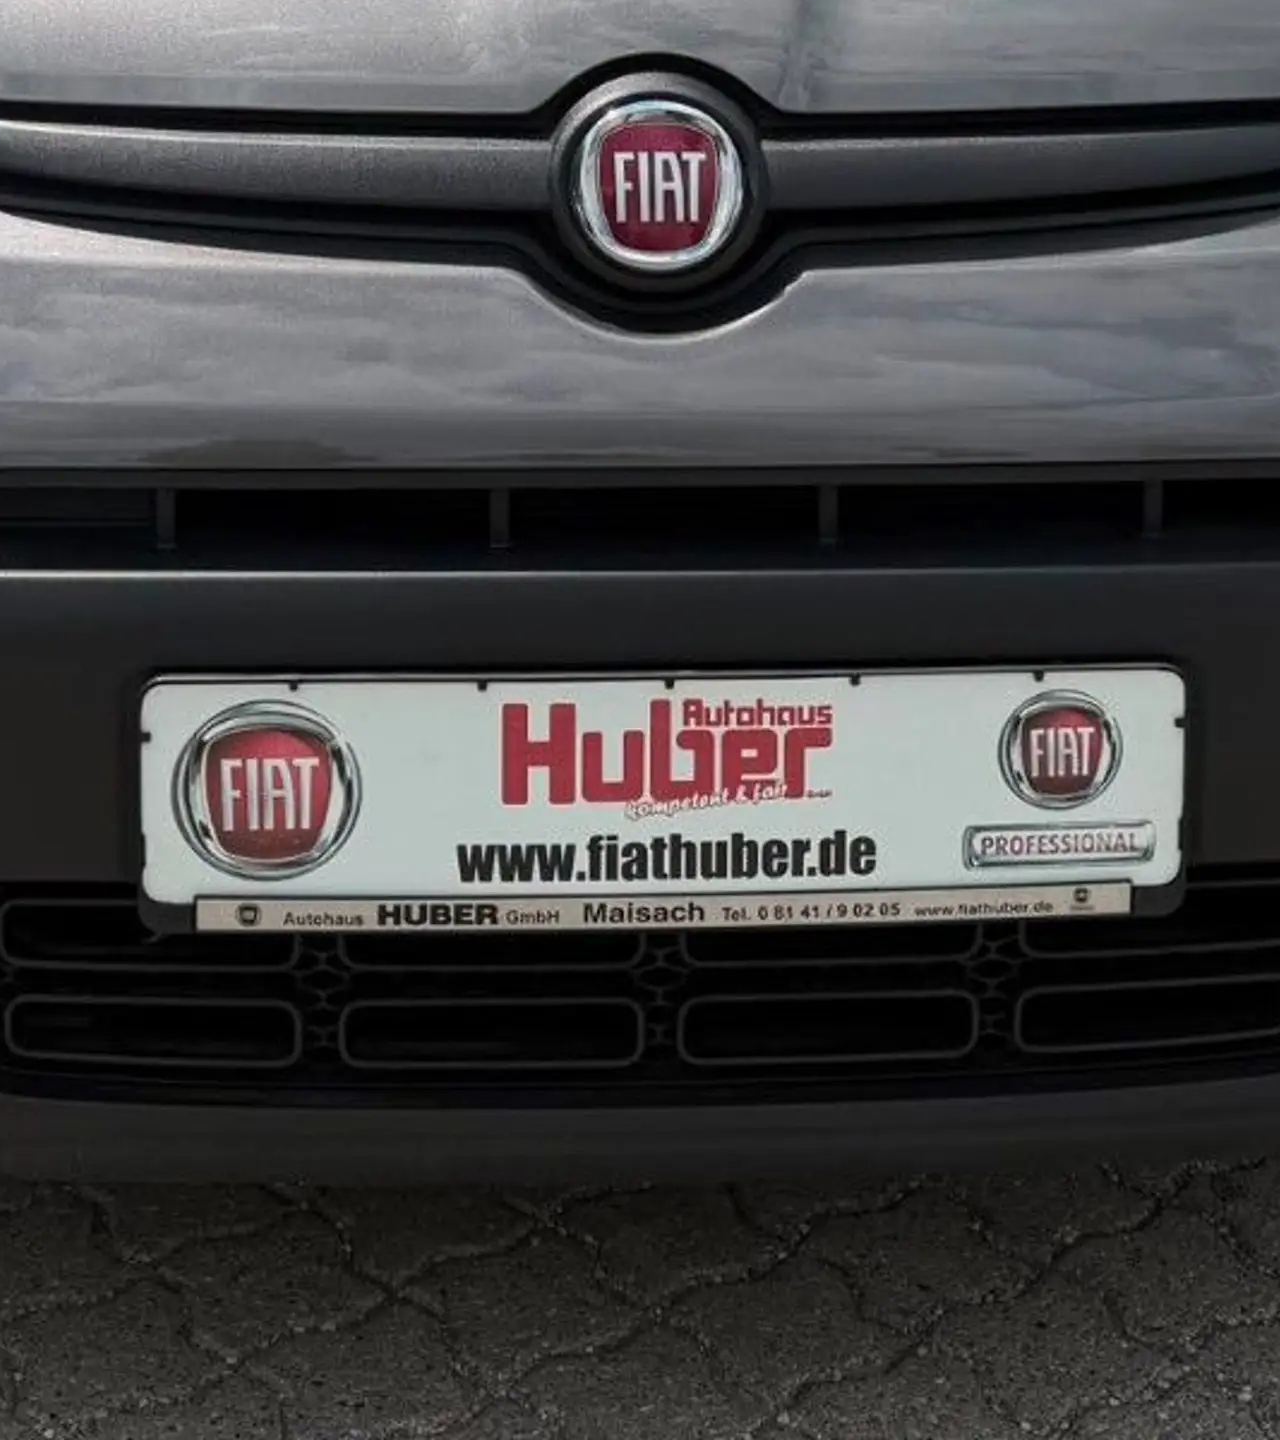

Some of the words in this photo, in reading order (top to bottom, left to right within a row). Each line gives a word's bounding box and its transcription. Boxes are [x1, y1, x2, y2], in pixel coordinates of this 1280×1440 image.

[613, 151, 706, 223] FIAT
[682, 698, 832, 727] Autohaus
[501, 698, 833, 806] Huber
[1029, 726, 1096, 778] FIAT
[220, 757, 320, 832] FIAT
[456, 830, 878, 883] www.fiathuber.de
[980, 831, 1138, 857] PROFESSIONAL
[282, 911, 365, 927] Autohaus
[376, 904, 499, 926] HUBER
[505, 909, 561, 925] GmbH
[582, 902, 706, 924] Maisach
[721, 906, 752, 922] Tel.
[757, 906, 769, 920] 0
[800, 904, 821, 920] 41
[851, 903, 875, 918] 02
[879, 902, 901, 918] 05
